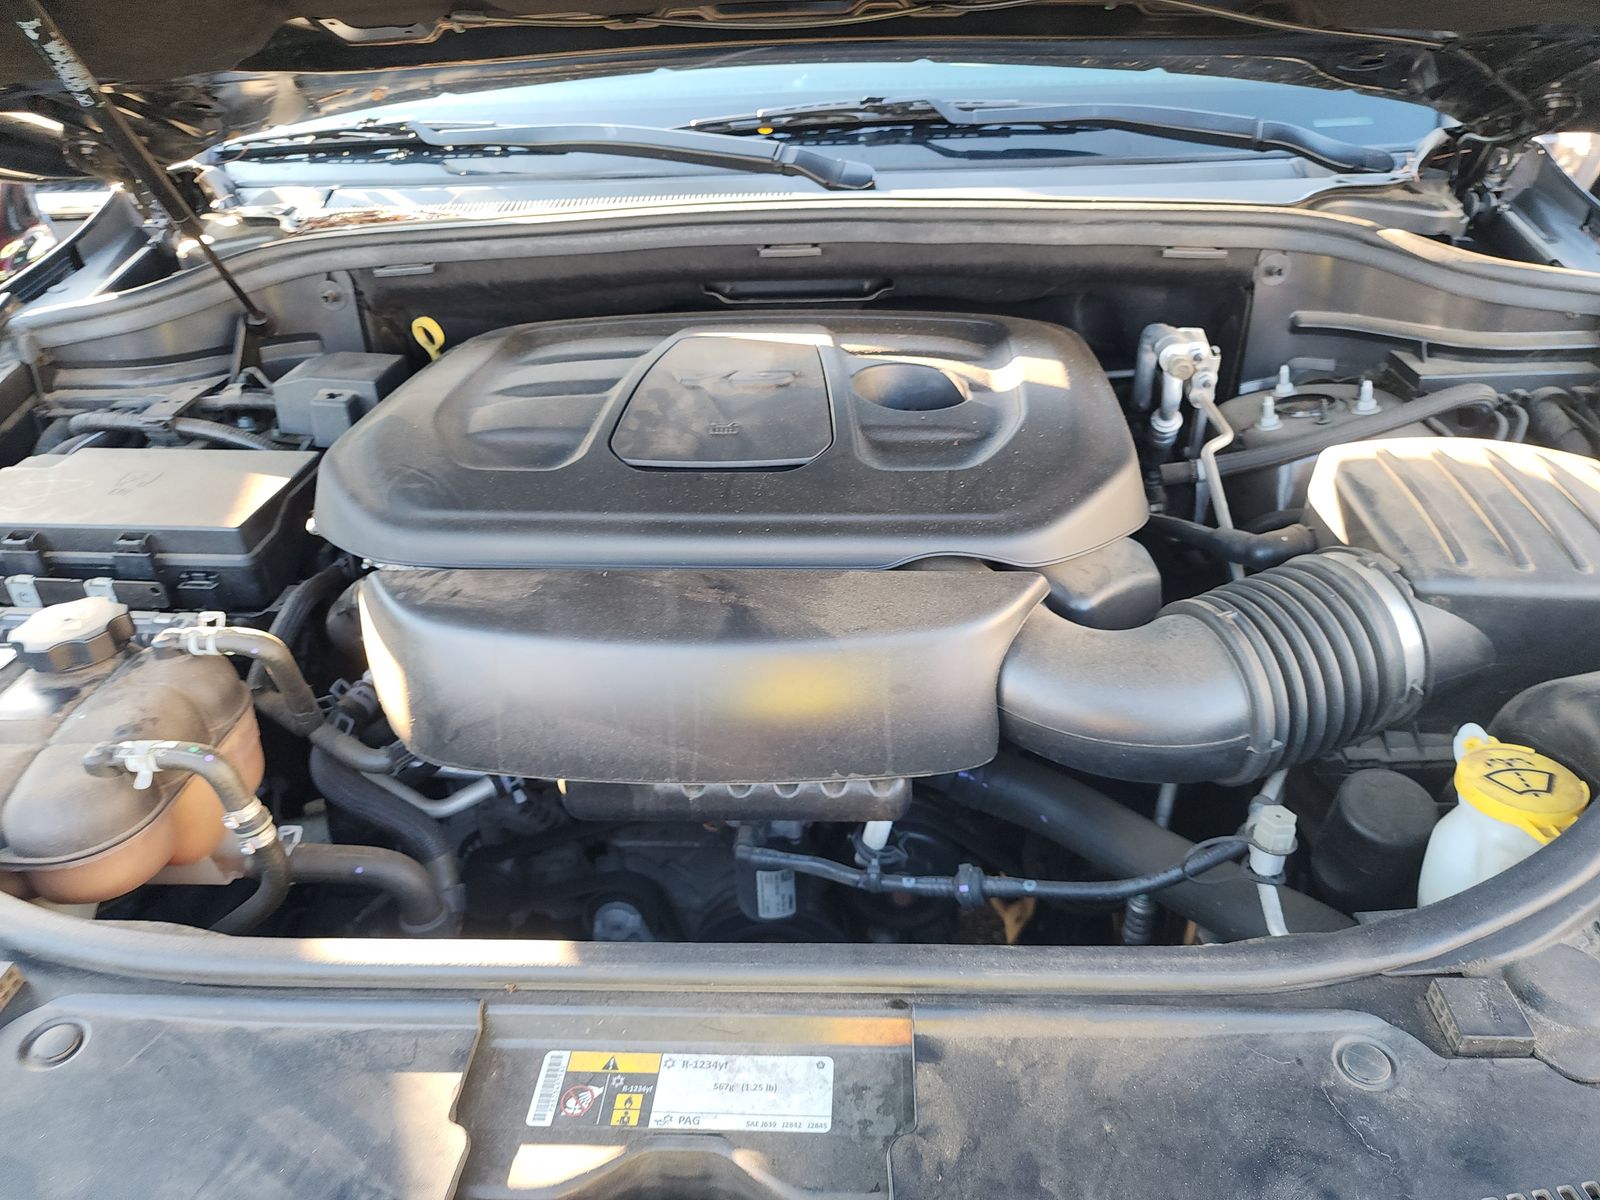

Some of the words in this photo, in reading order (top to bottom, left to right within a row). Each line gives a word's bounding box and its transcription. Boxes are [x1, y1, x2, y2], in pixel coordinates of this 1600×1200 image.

[713, 1083, 735, 1092] 567g
[741, 1083, 763, 1092] (1.25
[766, 1083, 778, 1093] lb)
[678, 1115, 701, 1126] PAG
